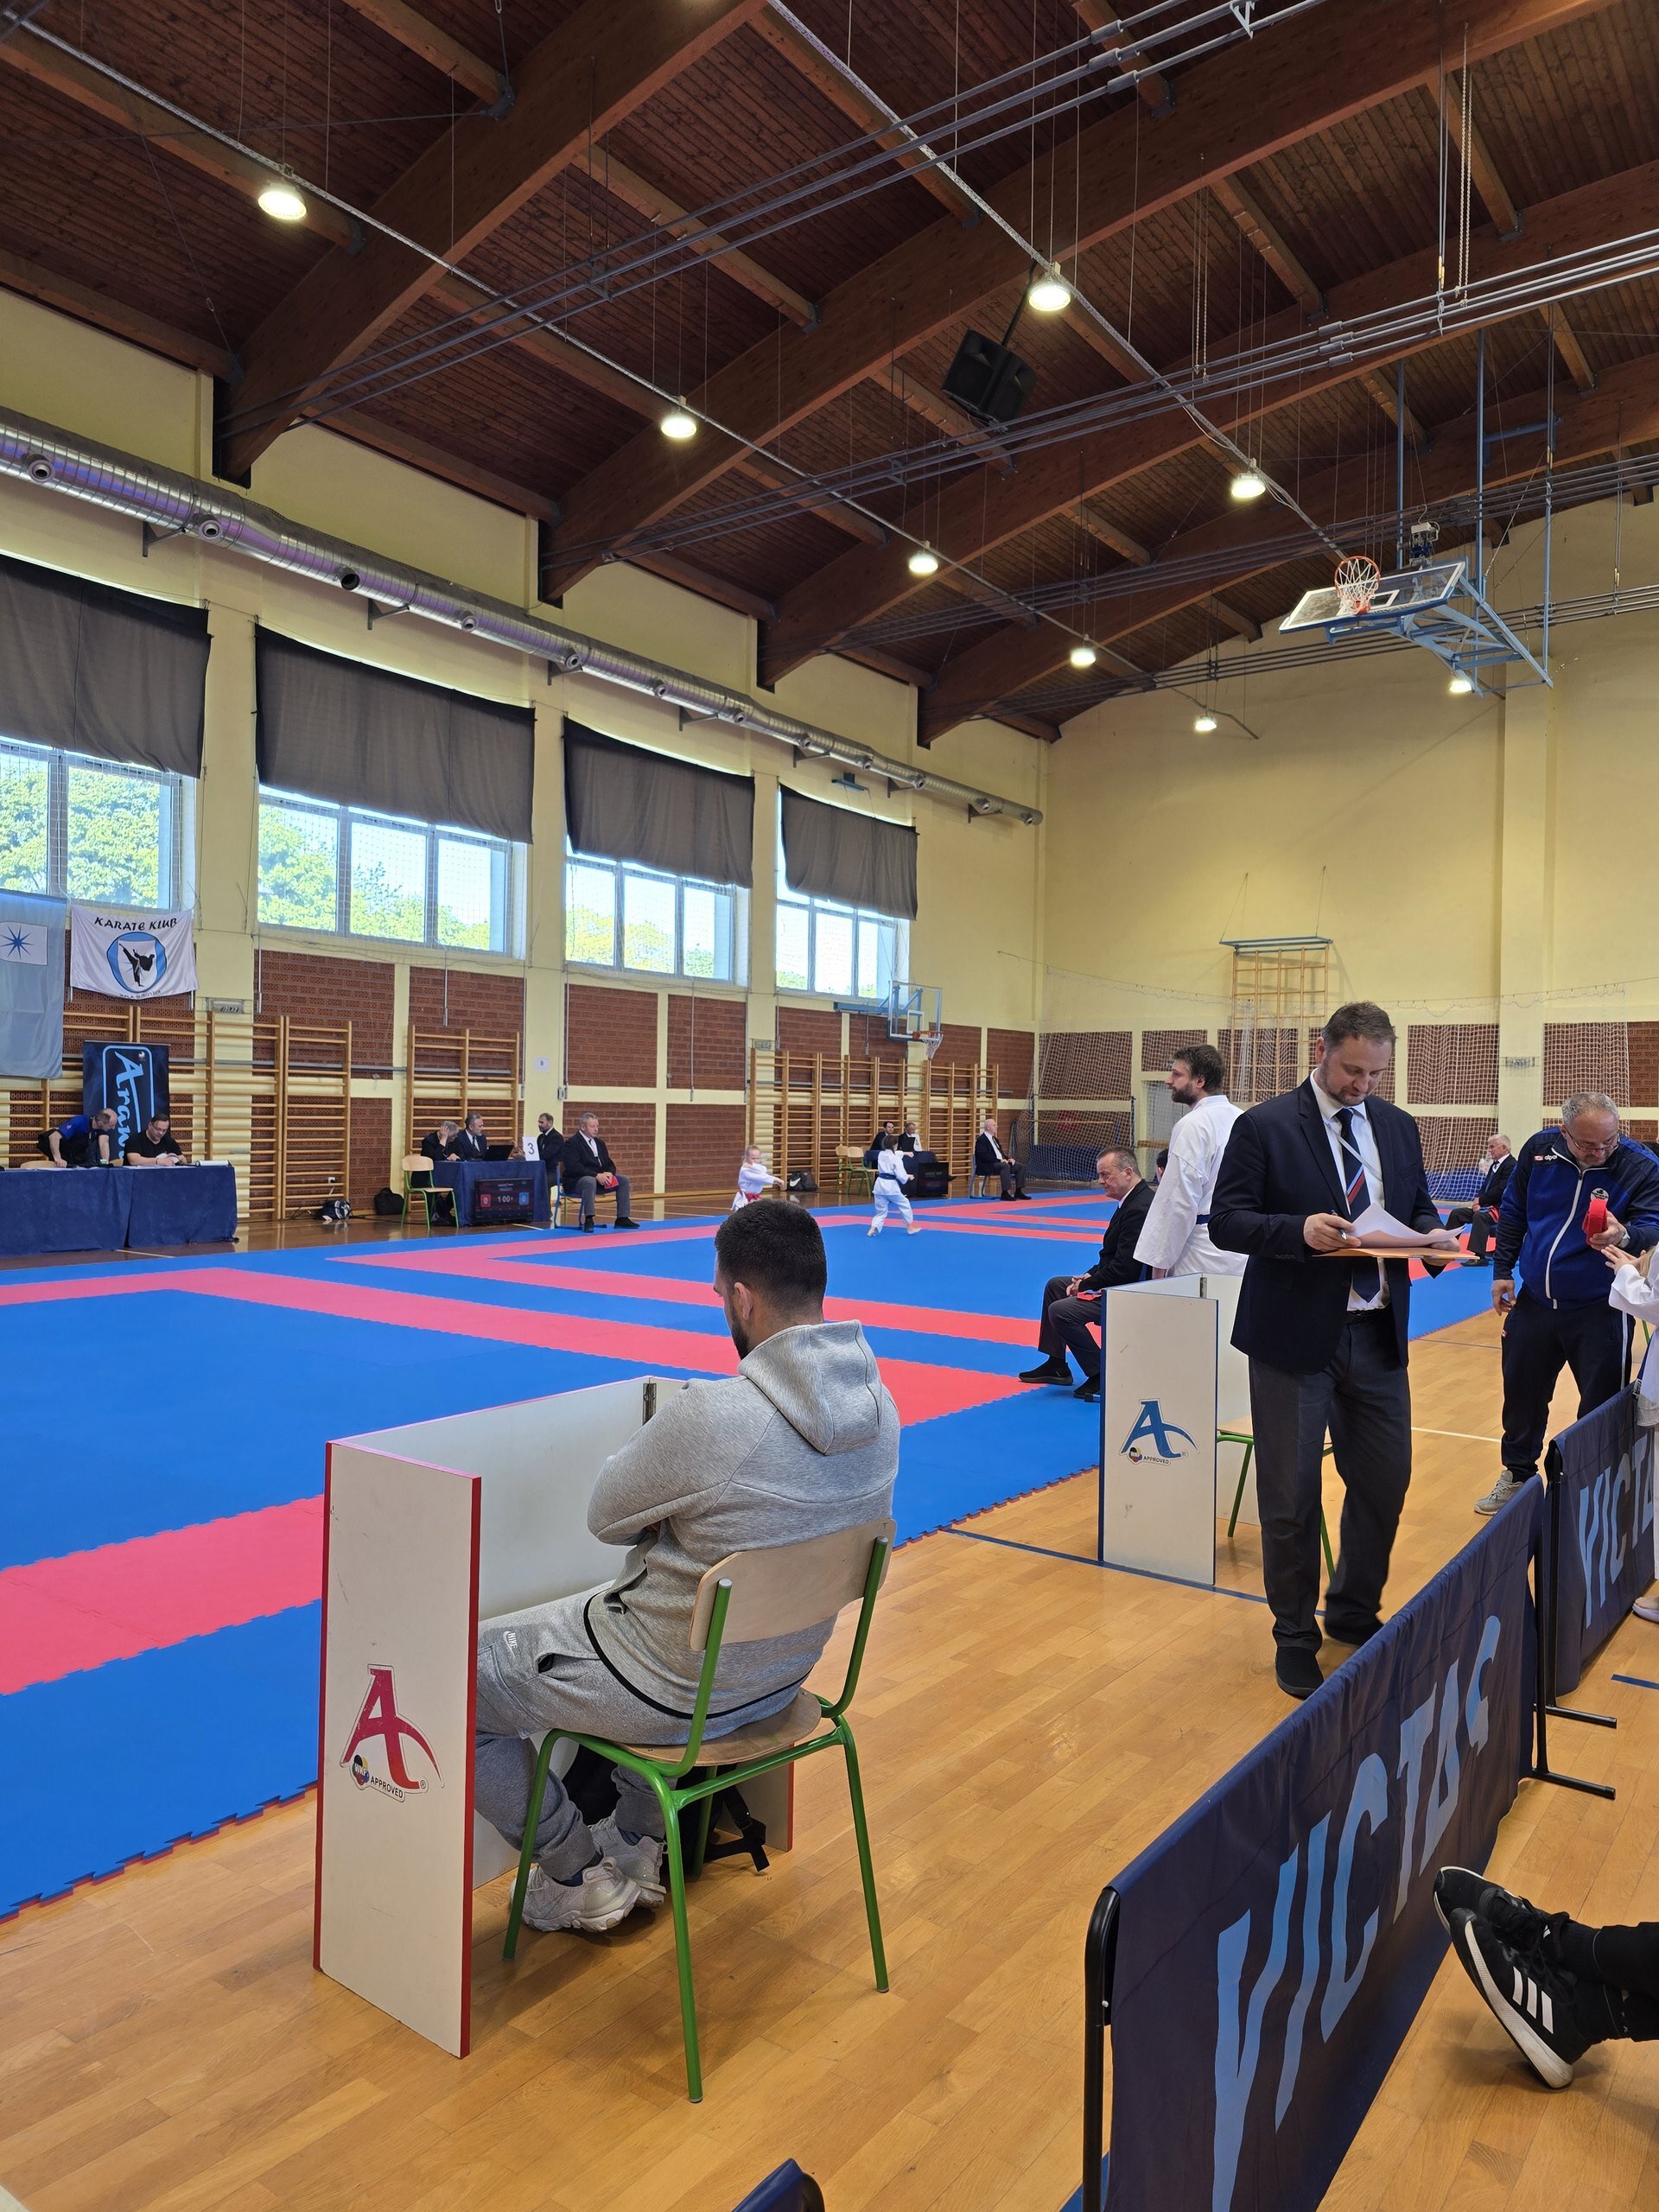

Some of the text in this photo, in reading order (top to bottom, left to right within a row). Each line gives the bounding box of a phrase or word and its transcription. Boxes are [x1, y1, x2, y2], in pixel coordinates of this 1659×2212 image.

[94, 917, 177, 931] KARATE KLUB
[116, 1051, 144, 1160] Araw
[527, 1142, 535, 1155] 3
[1580, 1433, 1655, 1629] VICTA
[507, 1632, 518, 1649] NIKE
[366, 1776, 404, 1798] APPROVED
